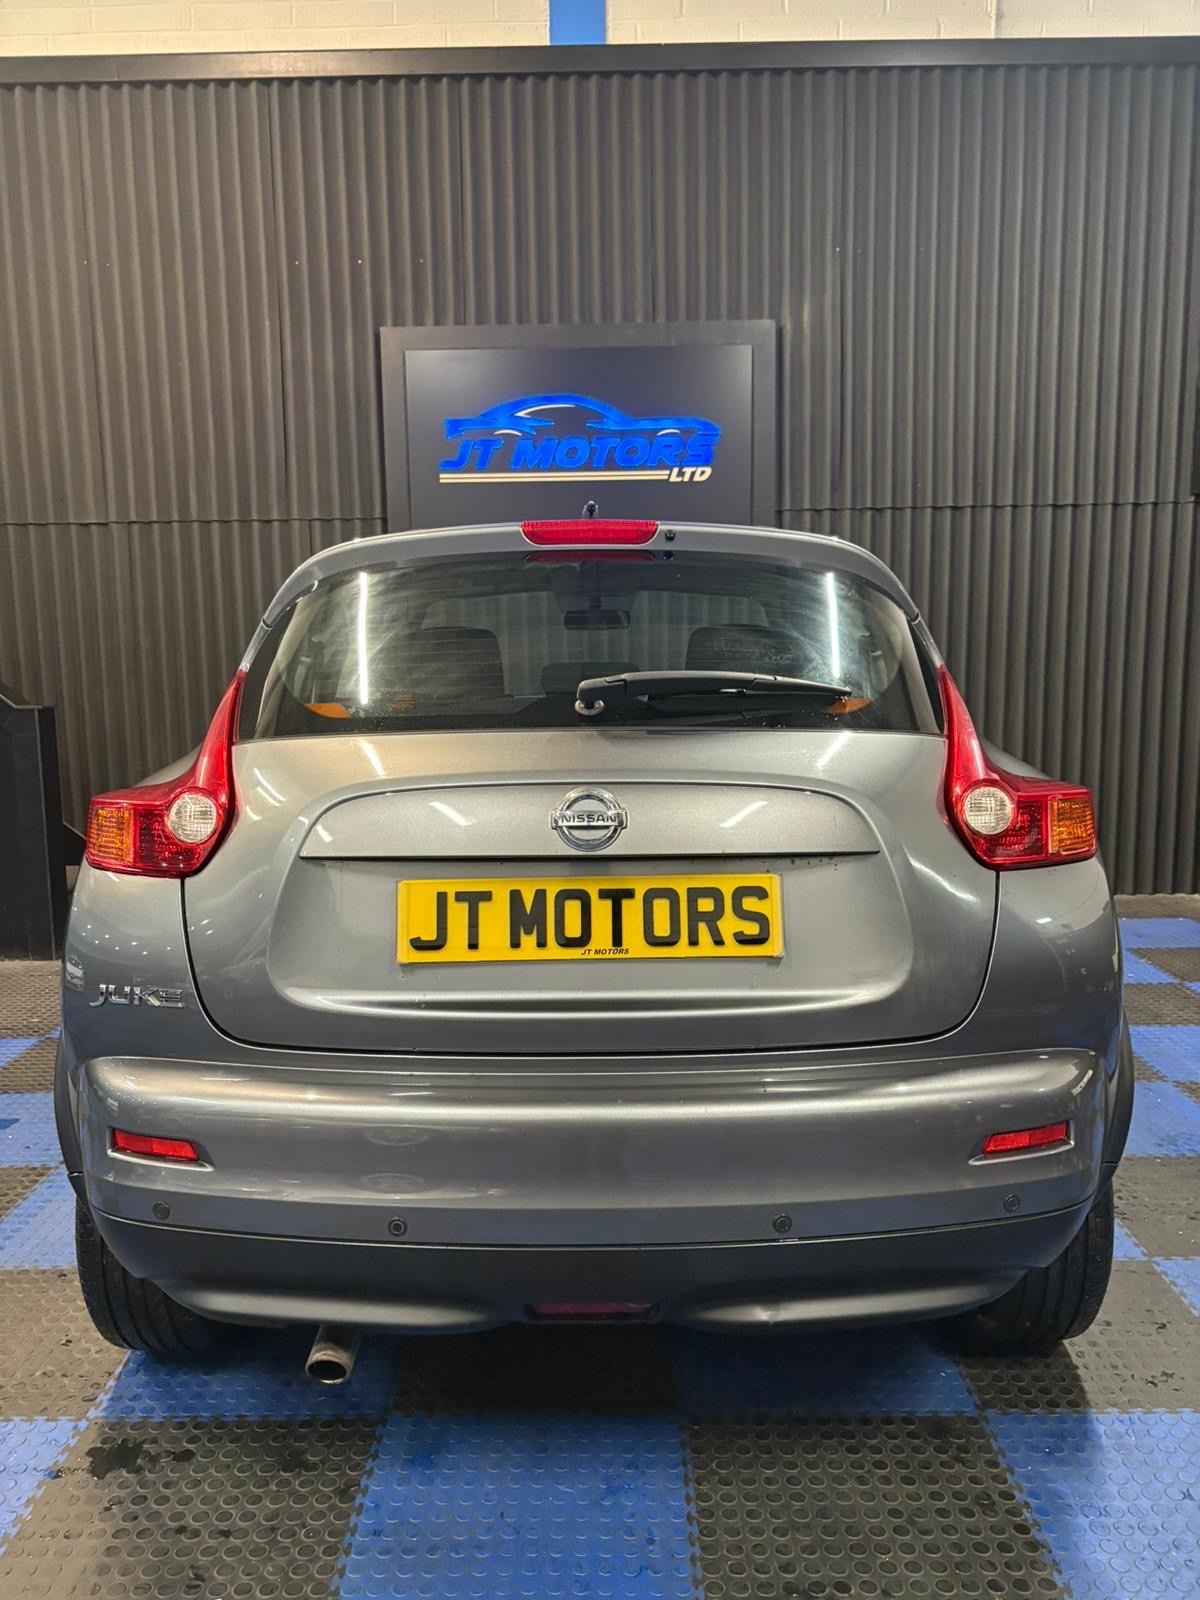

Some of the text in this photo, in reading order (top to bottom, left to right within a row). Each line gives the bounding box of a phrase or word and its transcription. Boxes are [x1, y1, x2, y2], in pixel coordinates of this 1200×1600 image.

[439, 434, 719, 471] JT MOTORS
[668, 467, 712, 482] LTD
[561, 814, 617, 823] NISSAN
[409, 885, 770, 951] JT MOTORS
[88, 984, 184, 1008] JUKE
